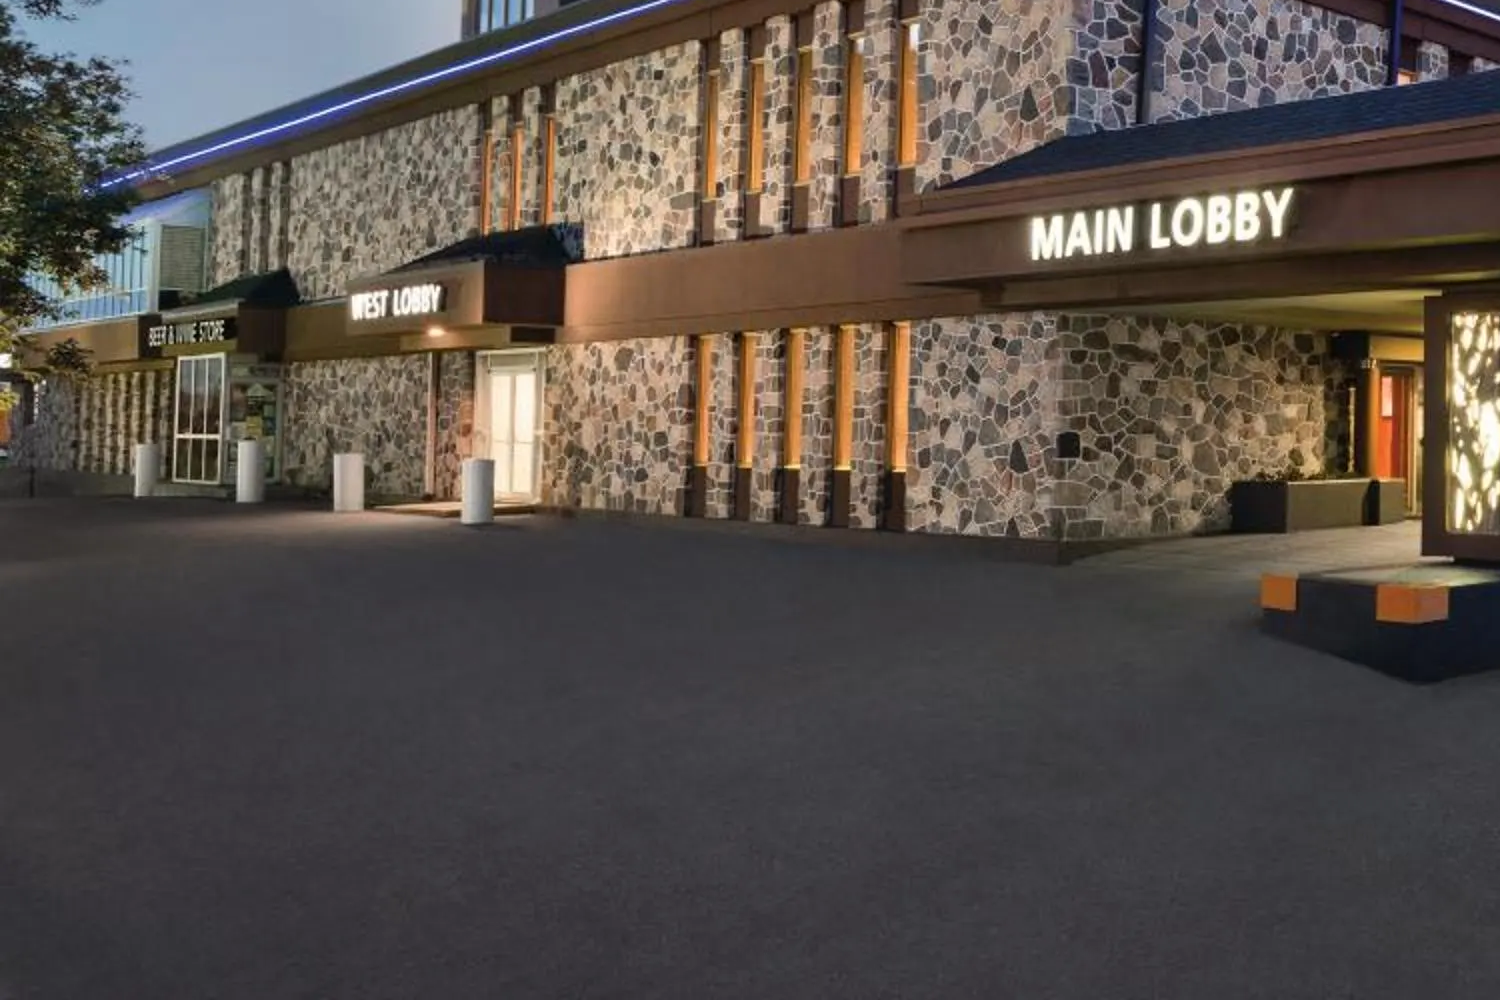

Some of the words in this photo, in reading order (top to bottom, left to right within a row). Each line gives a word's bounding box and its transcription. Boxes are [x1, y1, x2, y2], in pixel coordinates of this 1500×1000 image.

[1030, 207, 1133, 260] MAIN
[1150, 188, 1294, 249] LOBBY
[351, 290, 389, 320] WEST
[393, 283, 441, 316] LOBBY
